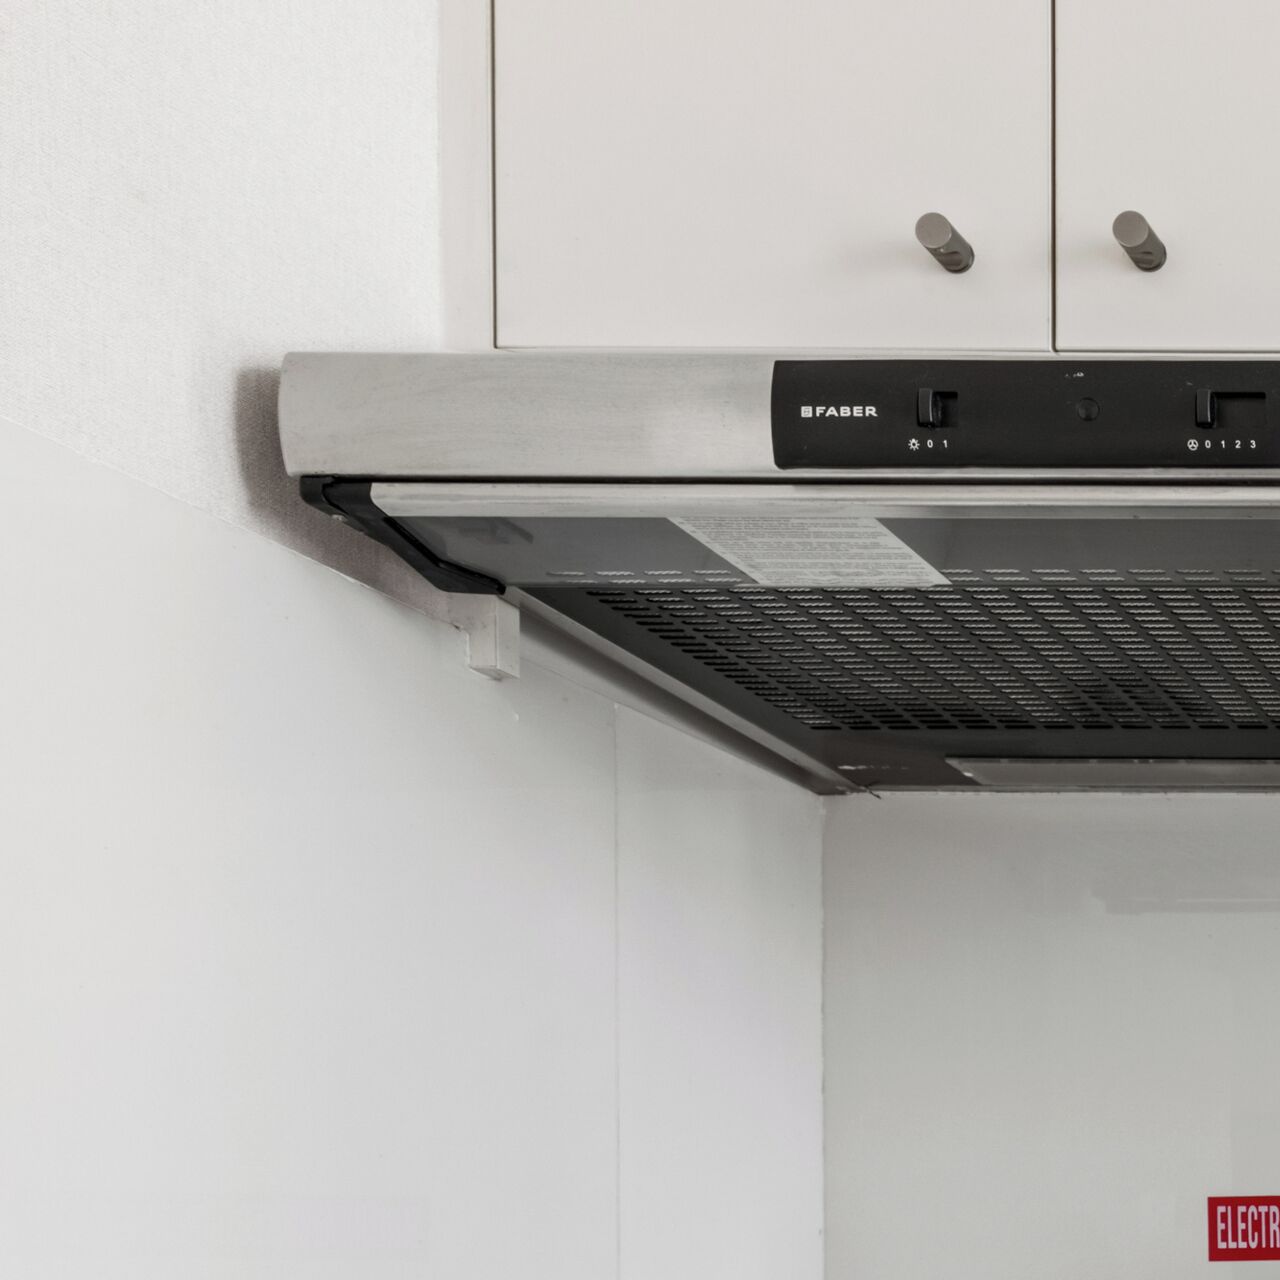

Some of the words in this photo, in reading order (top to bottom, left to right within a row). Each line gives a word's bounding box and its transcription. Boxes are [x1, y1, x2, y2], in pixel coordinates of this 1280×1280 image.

[815, 405, 878, 417] FABER
[926, 439, 934, 448] 0
[942, 439, 949, 448] 1
[1204, 439, 1211, 449] 0
[1220, 439, 1226, 449] 1
[1235, 439, 1242, 449] 2
[1249, 439, 1257, 449] 3
